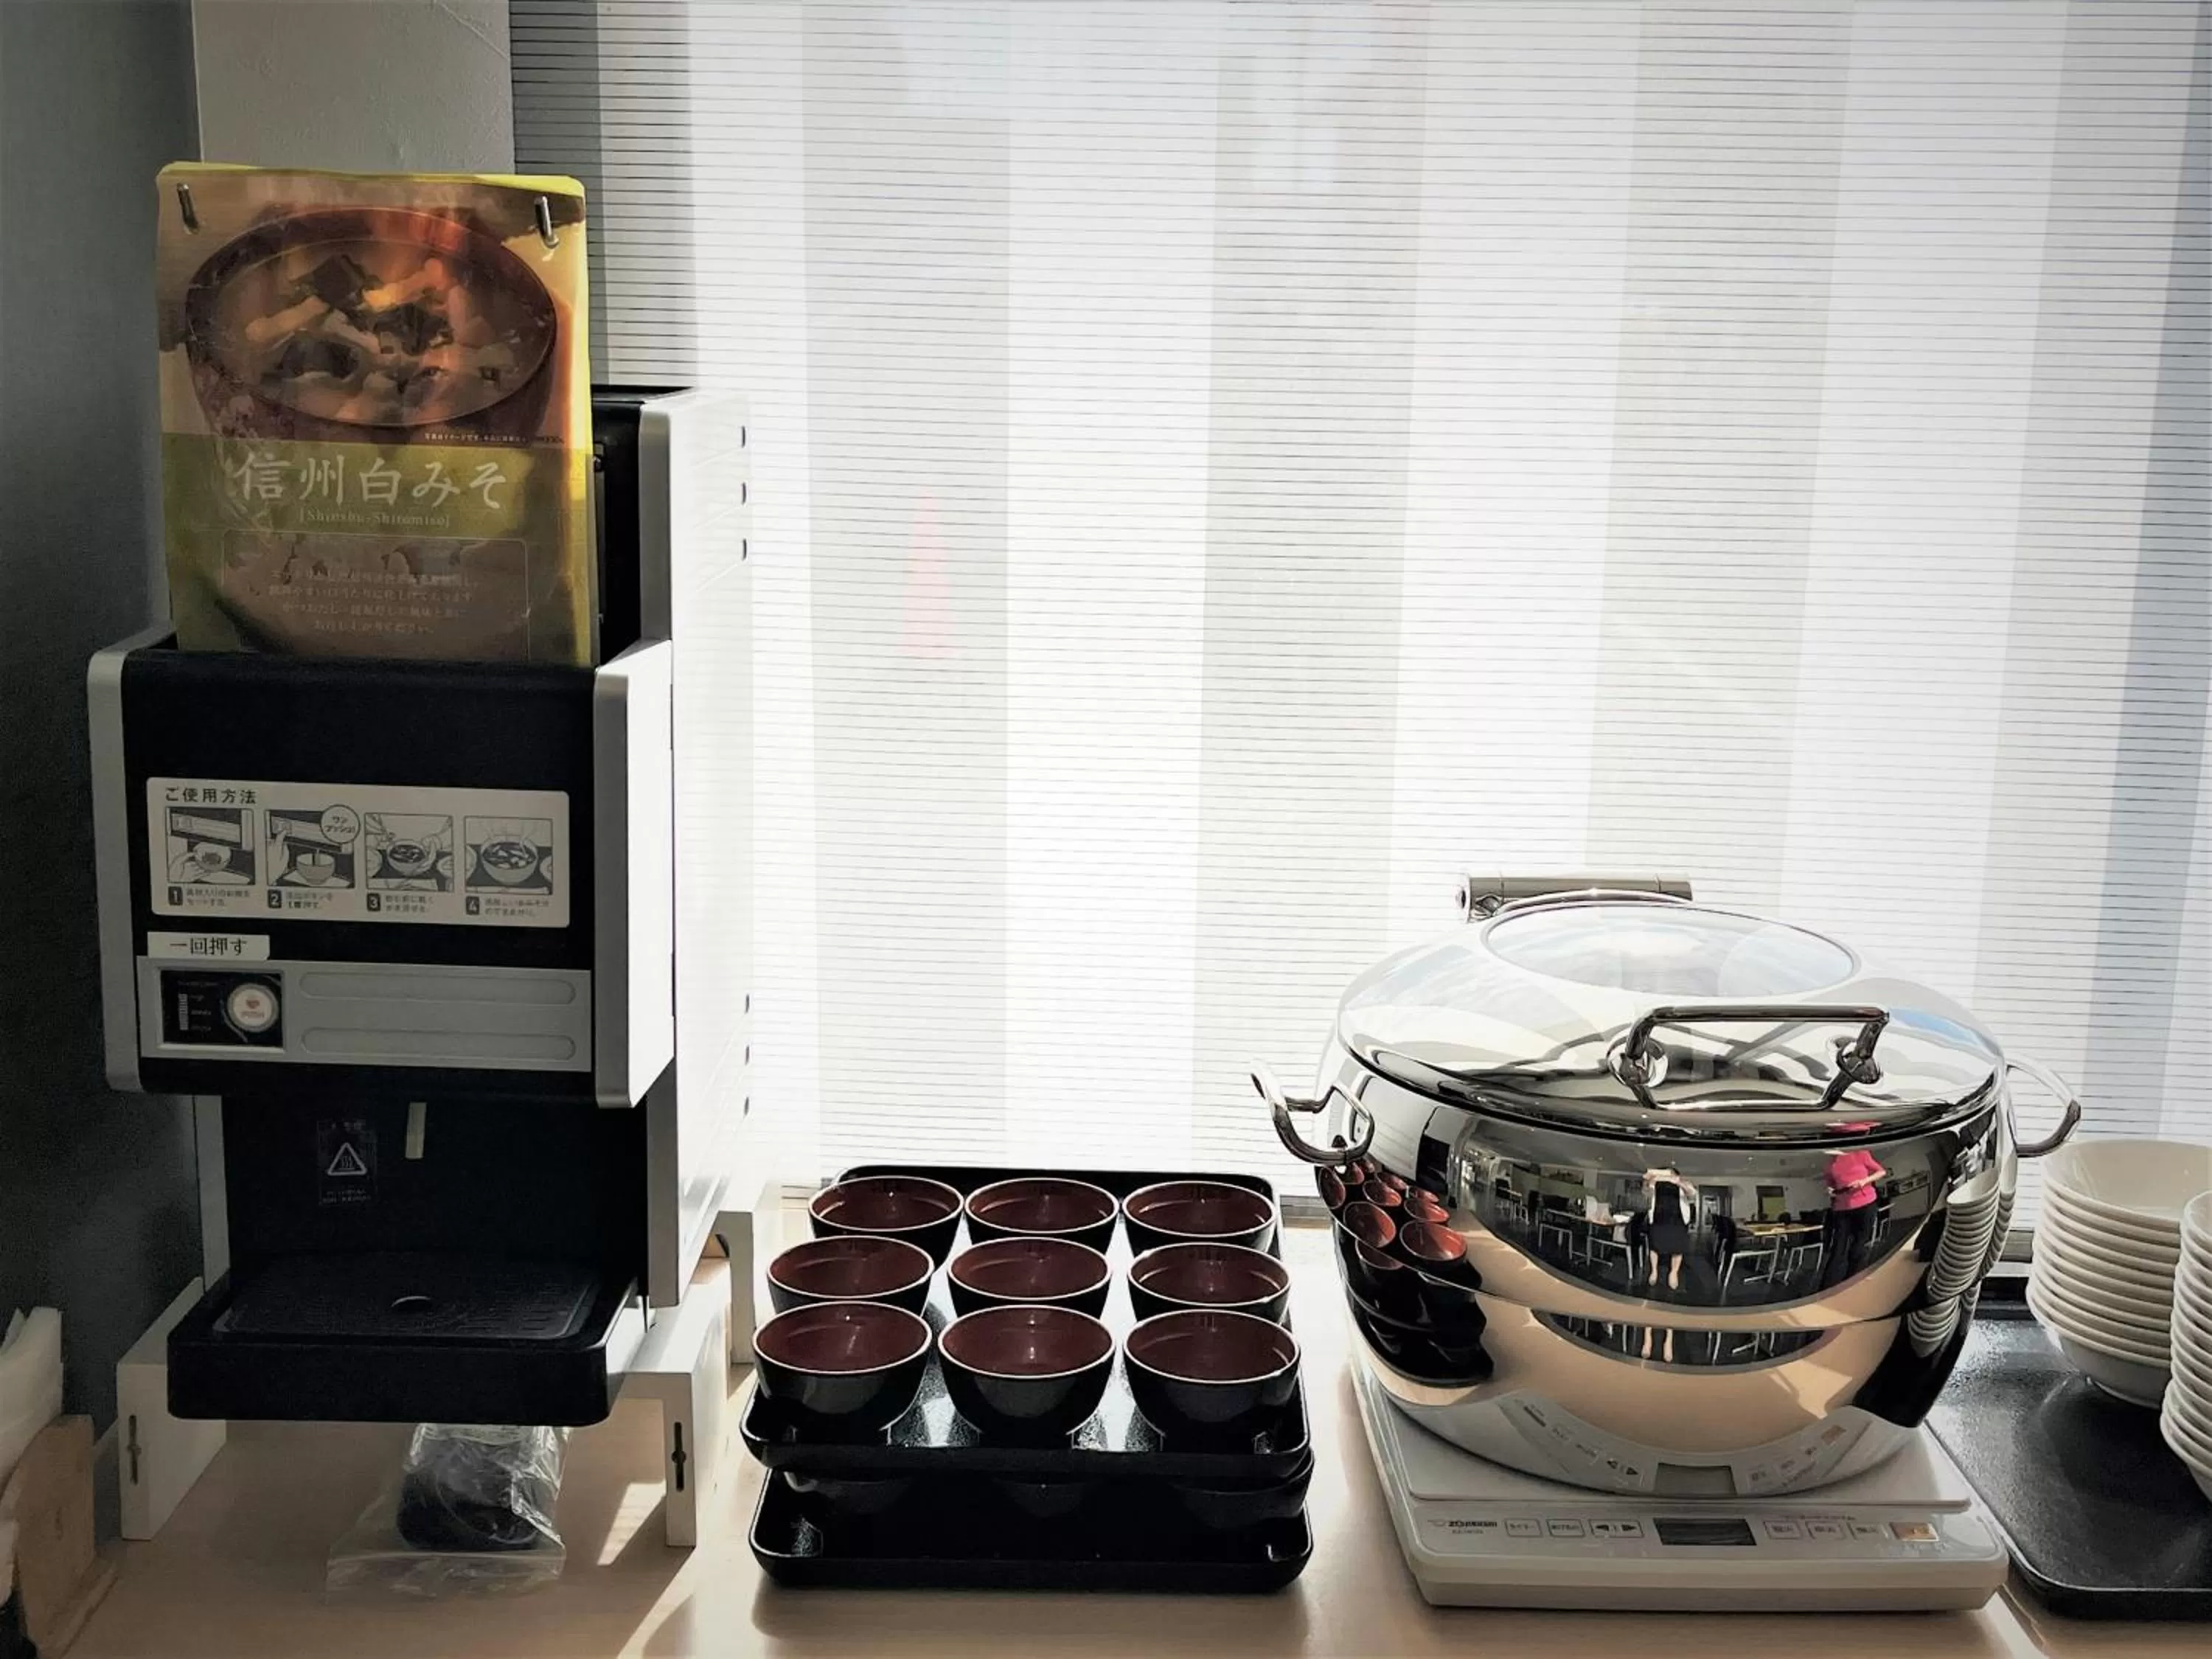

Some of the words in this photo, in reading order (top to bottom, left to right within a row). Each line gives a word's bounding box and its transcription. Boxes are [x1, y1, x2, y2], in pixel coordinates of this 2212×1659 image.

[233, 451, 507, 509] 信州白みそ
[165, 787, 257, 804] ご使用方法
[170, 937, 248, 956] 一回押す
